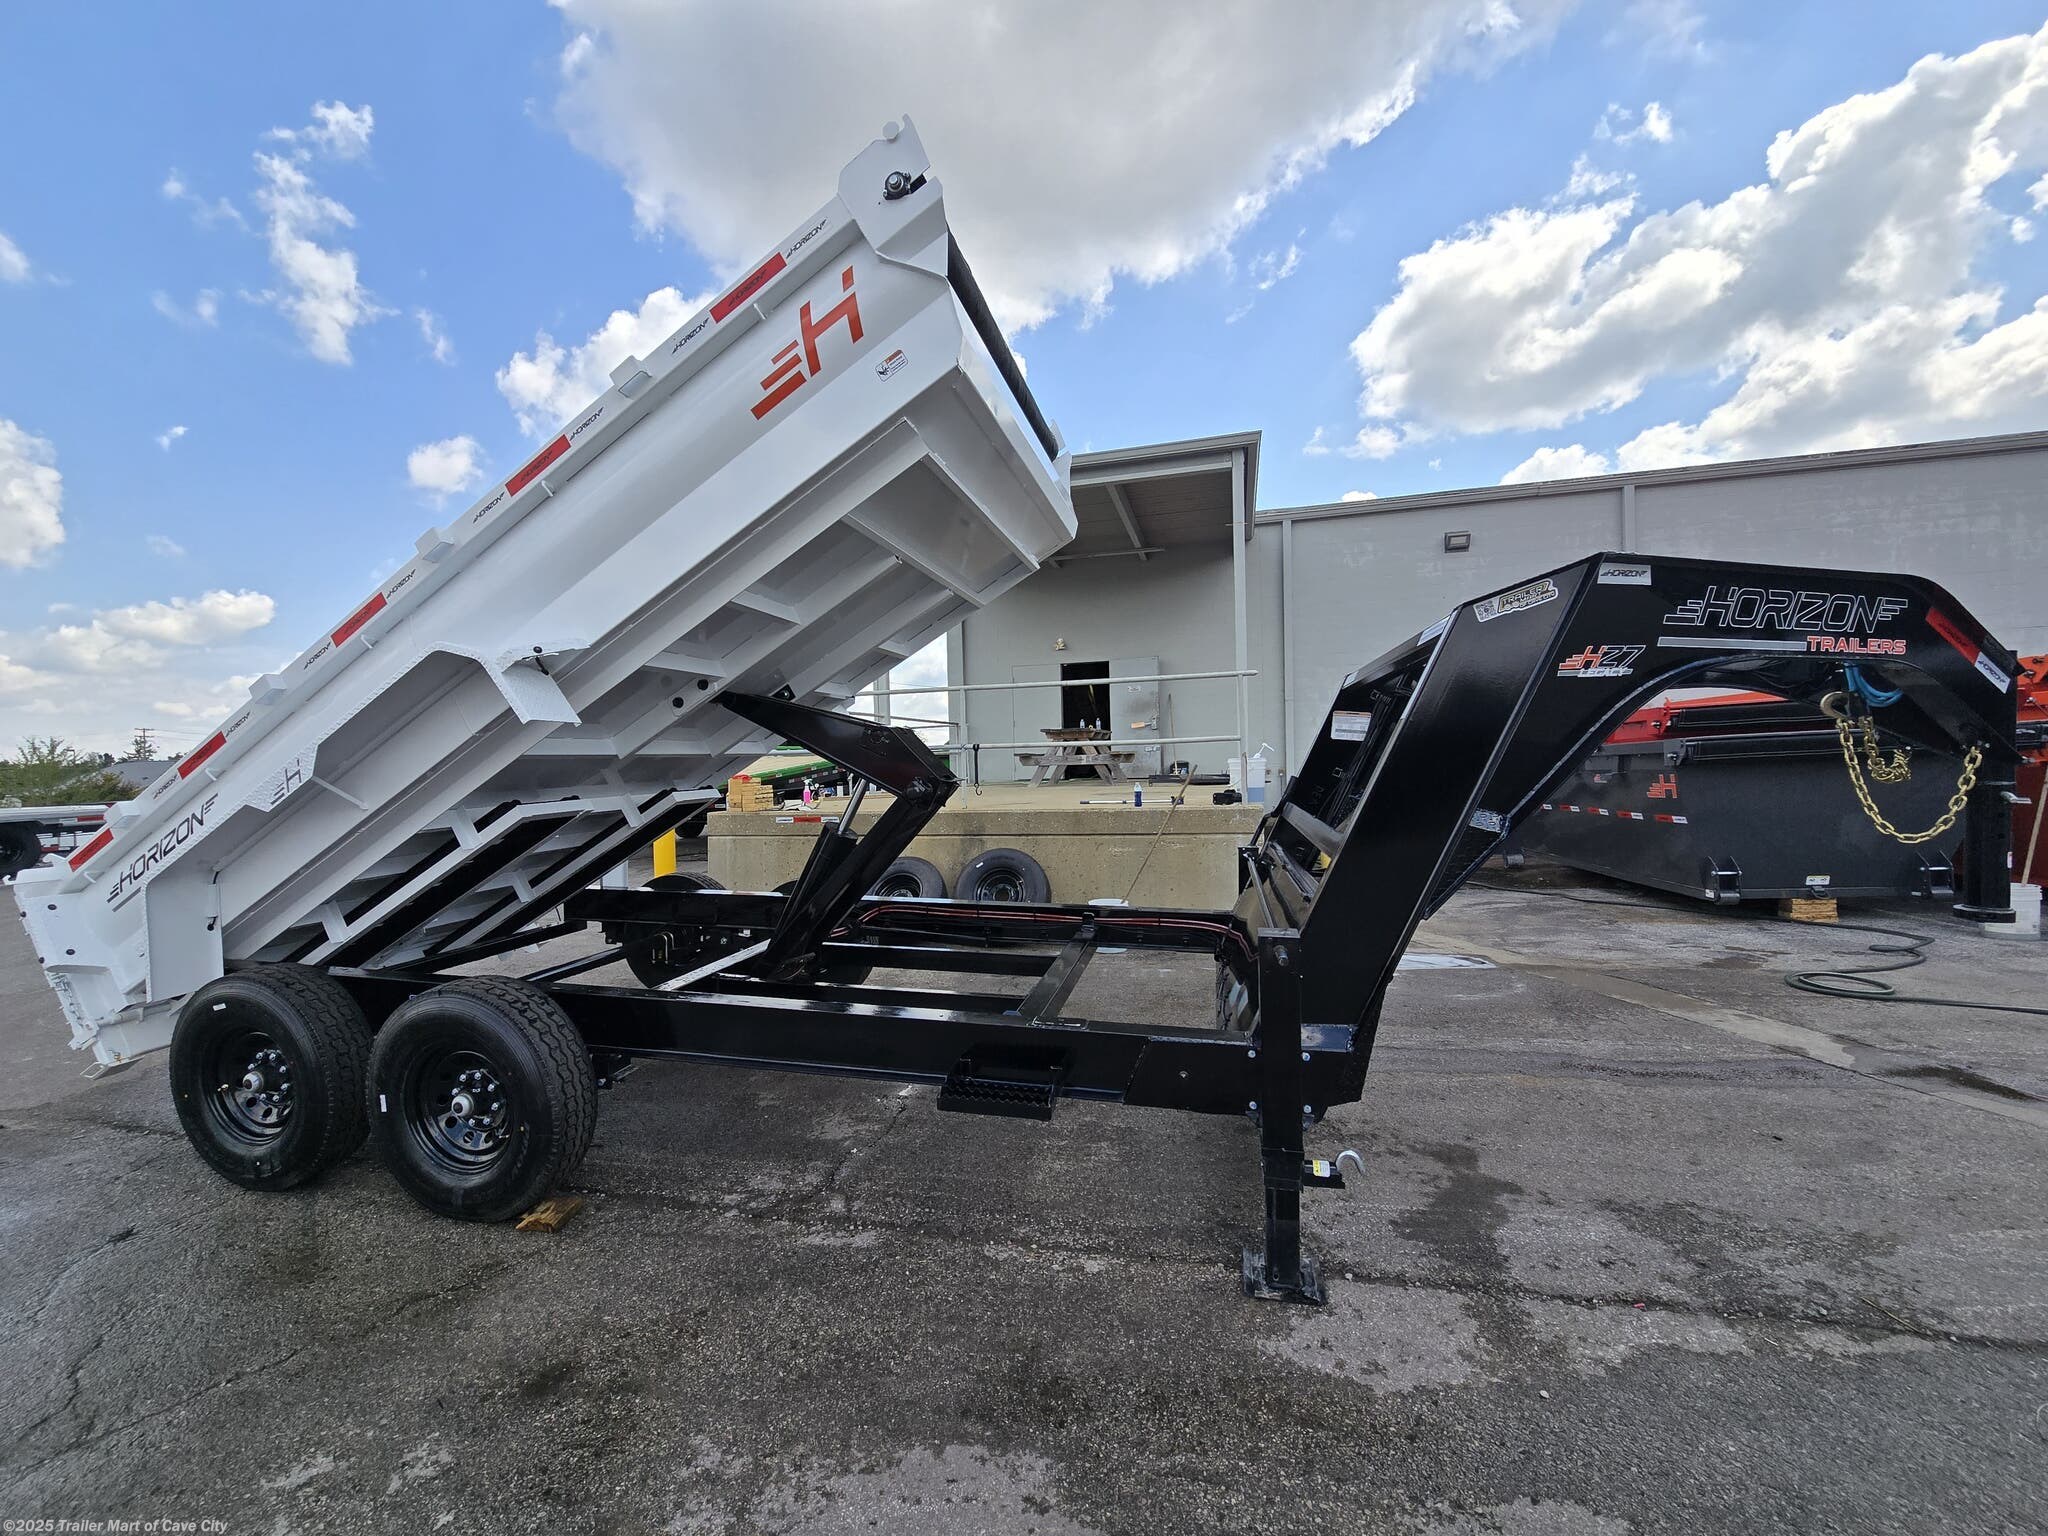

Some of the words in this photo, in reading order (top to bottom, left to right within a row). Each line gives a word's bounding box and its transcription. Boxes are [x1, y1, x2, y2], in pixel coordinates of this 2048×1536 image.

[787, 220, 826, 257] HORIZON
[673, 319, 708, 353] HORIZON
[571, 408, 603, 440] HORIZON
[1602, 568, 1647, 578] HORIZON
[1694, 585, 1886, 634] HORIZON
[1806, 635, 1907, 655] TRAILERS
[117, 802, 207, 894] HORIZON
